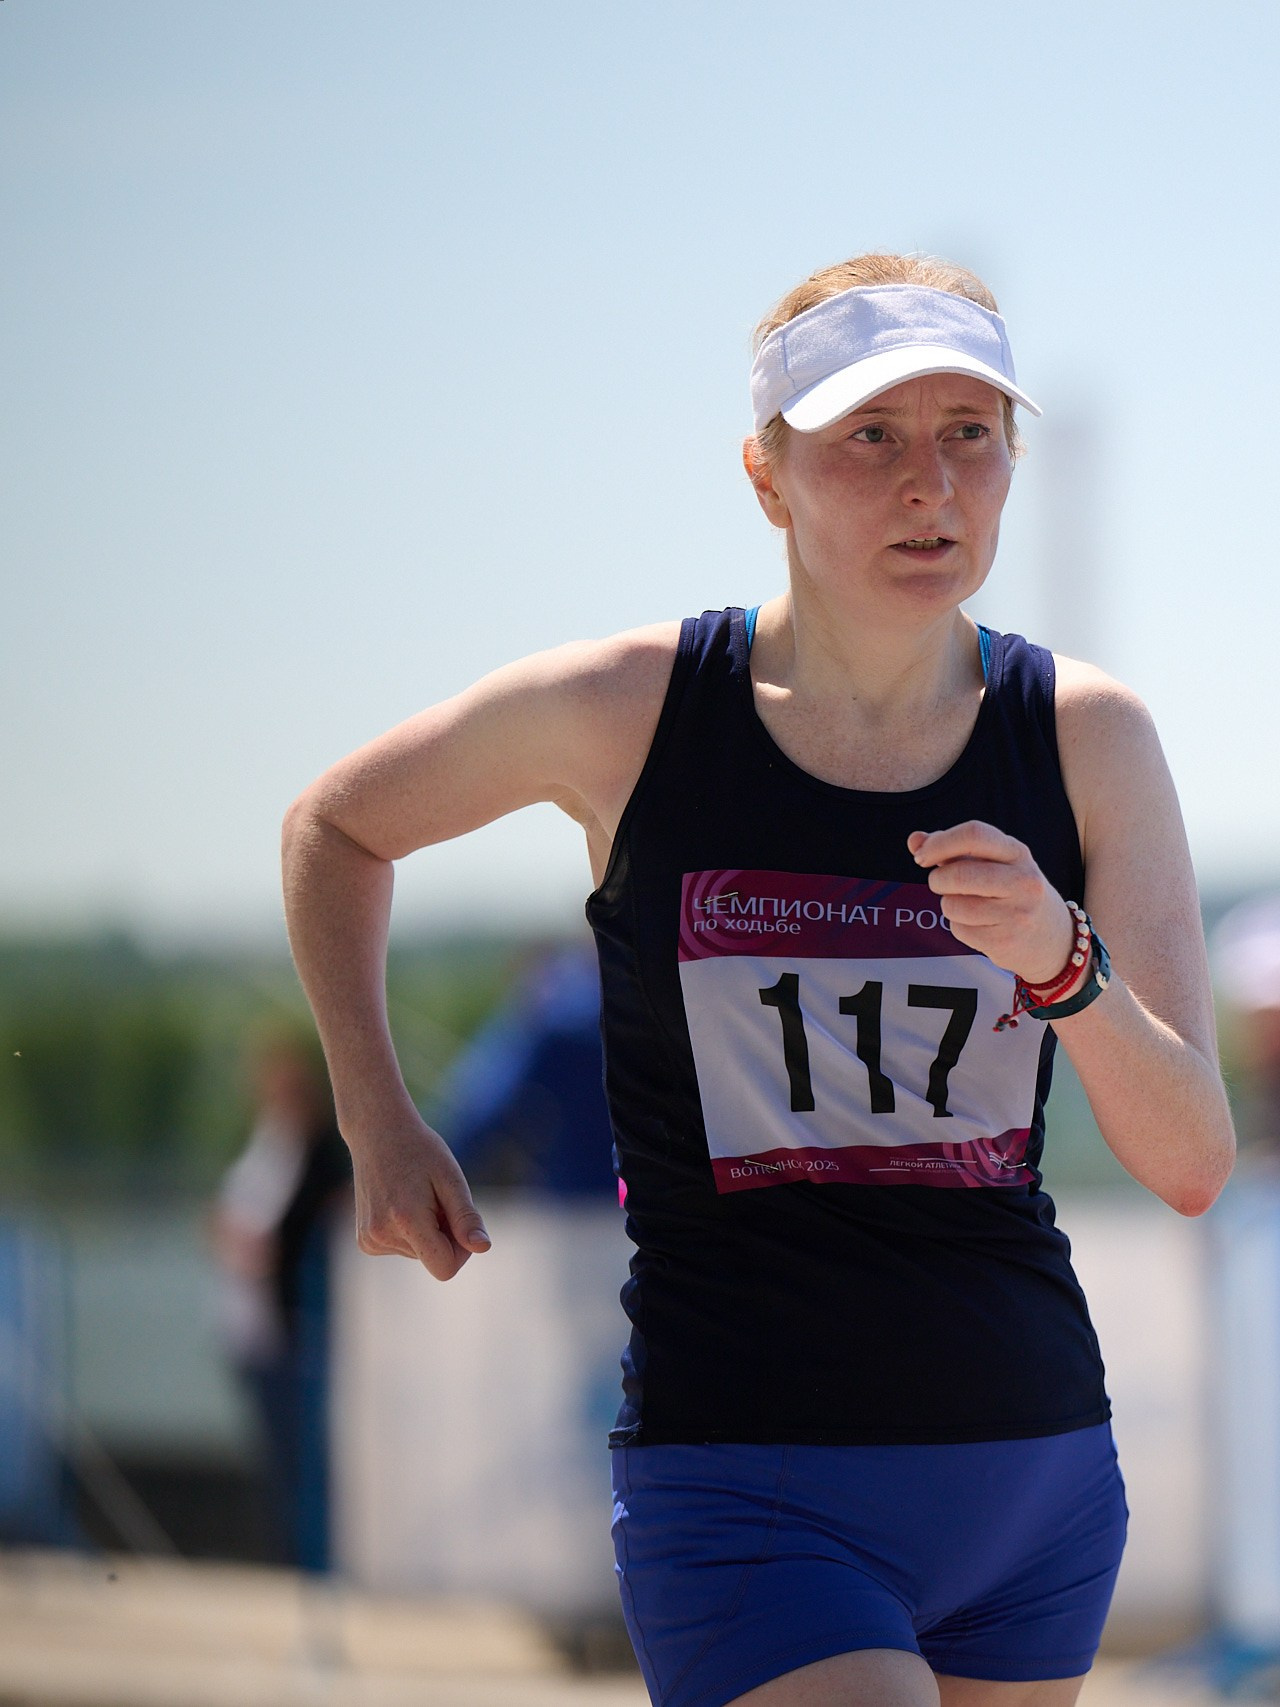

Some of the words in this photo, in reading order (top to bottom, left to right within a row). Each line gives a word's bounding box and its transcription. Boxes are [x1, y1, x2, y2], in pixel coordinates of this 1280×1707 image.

[693, 895, 886, 926] ЧЕМПИОНАТ
[693, 918, 719, 934] по
[724, 917, 802, 936] ходьбе
[758, 972, 979, 1118] 117
[804, 1159, 840, 1172] 2025
[889, 1160, 923, 1169] ЛЕГКОЙ
